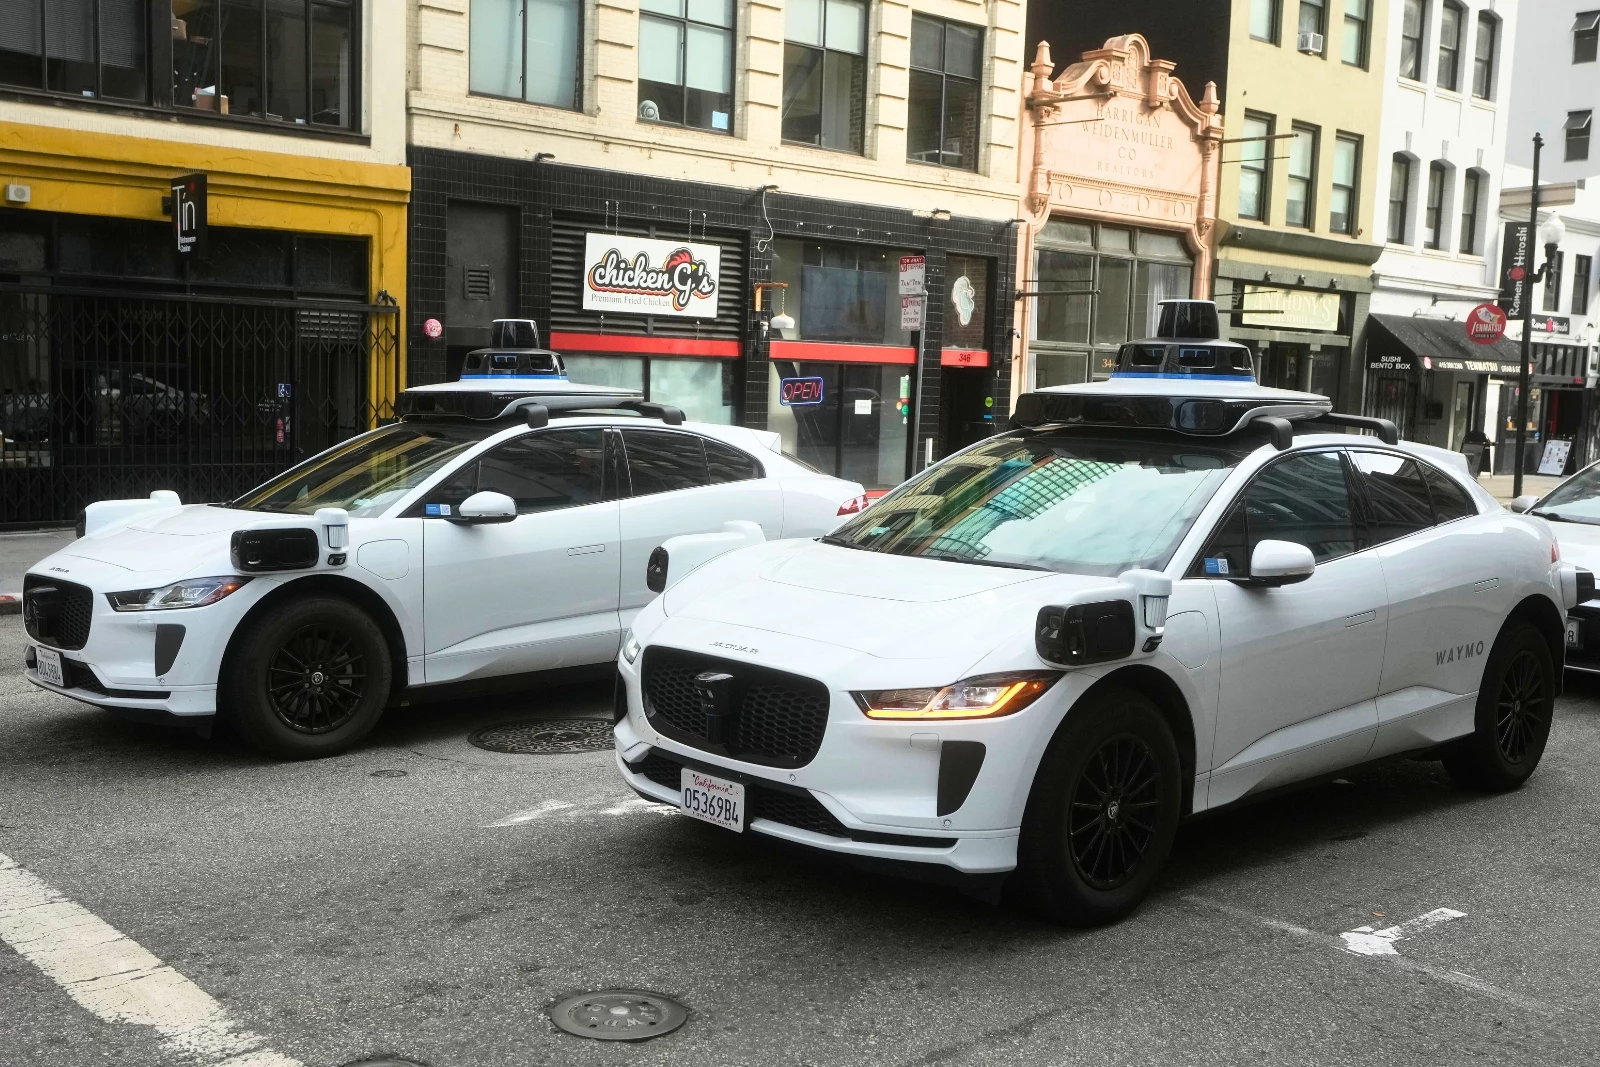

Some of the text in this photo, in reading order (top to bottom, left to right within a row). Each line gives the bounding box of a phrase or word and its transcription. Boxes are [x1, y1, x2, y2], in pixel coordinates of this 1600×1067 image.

[1096, 104, 1161, 128] HARRIGAN
[1082, 121, 1173, 149] WEIDENMULLER
[1097, 161, 1154, 179] REALTORS
[1508, 226, 1527, 316] Ramen Hiroshi
[591, 293, 622, 304] Premium
[624, 296, 642, 305] Fried
[959, 353, 971, 362] 346
[1380, 355, 1402, 363] SUSHI
[1464, 360, 1498, 372] TENMATSU
[783, 381, 822, 400] OPEN
[1436, 640, 1484, 666] WAYMO
[694, 775, 734, 796] California
[684, 787, 739, 825] 05369B4
